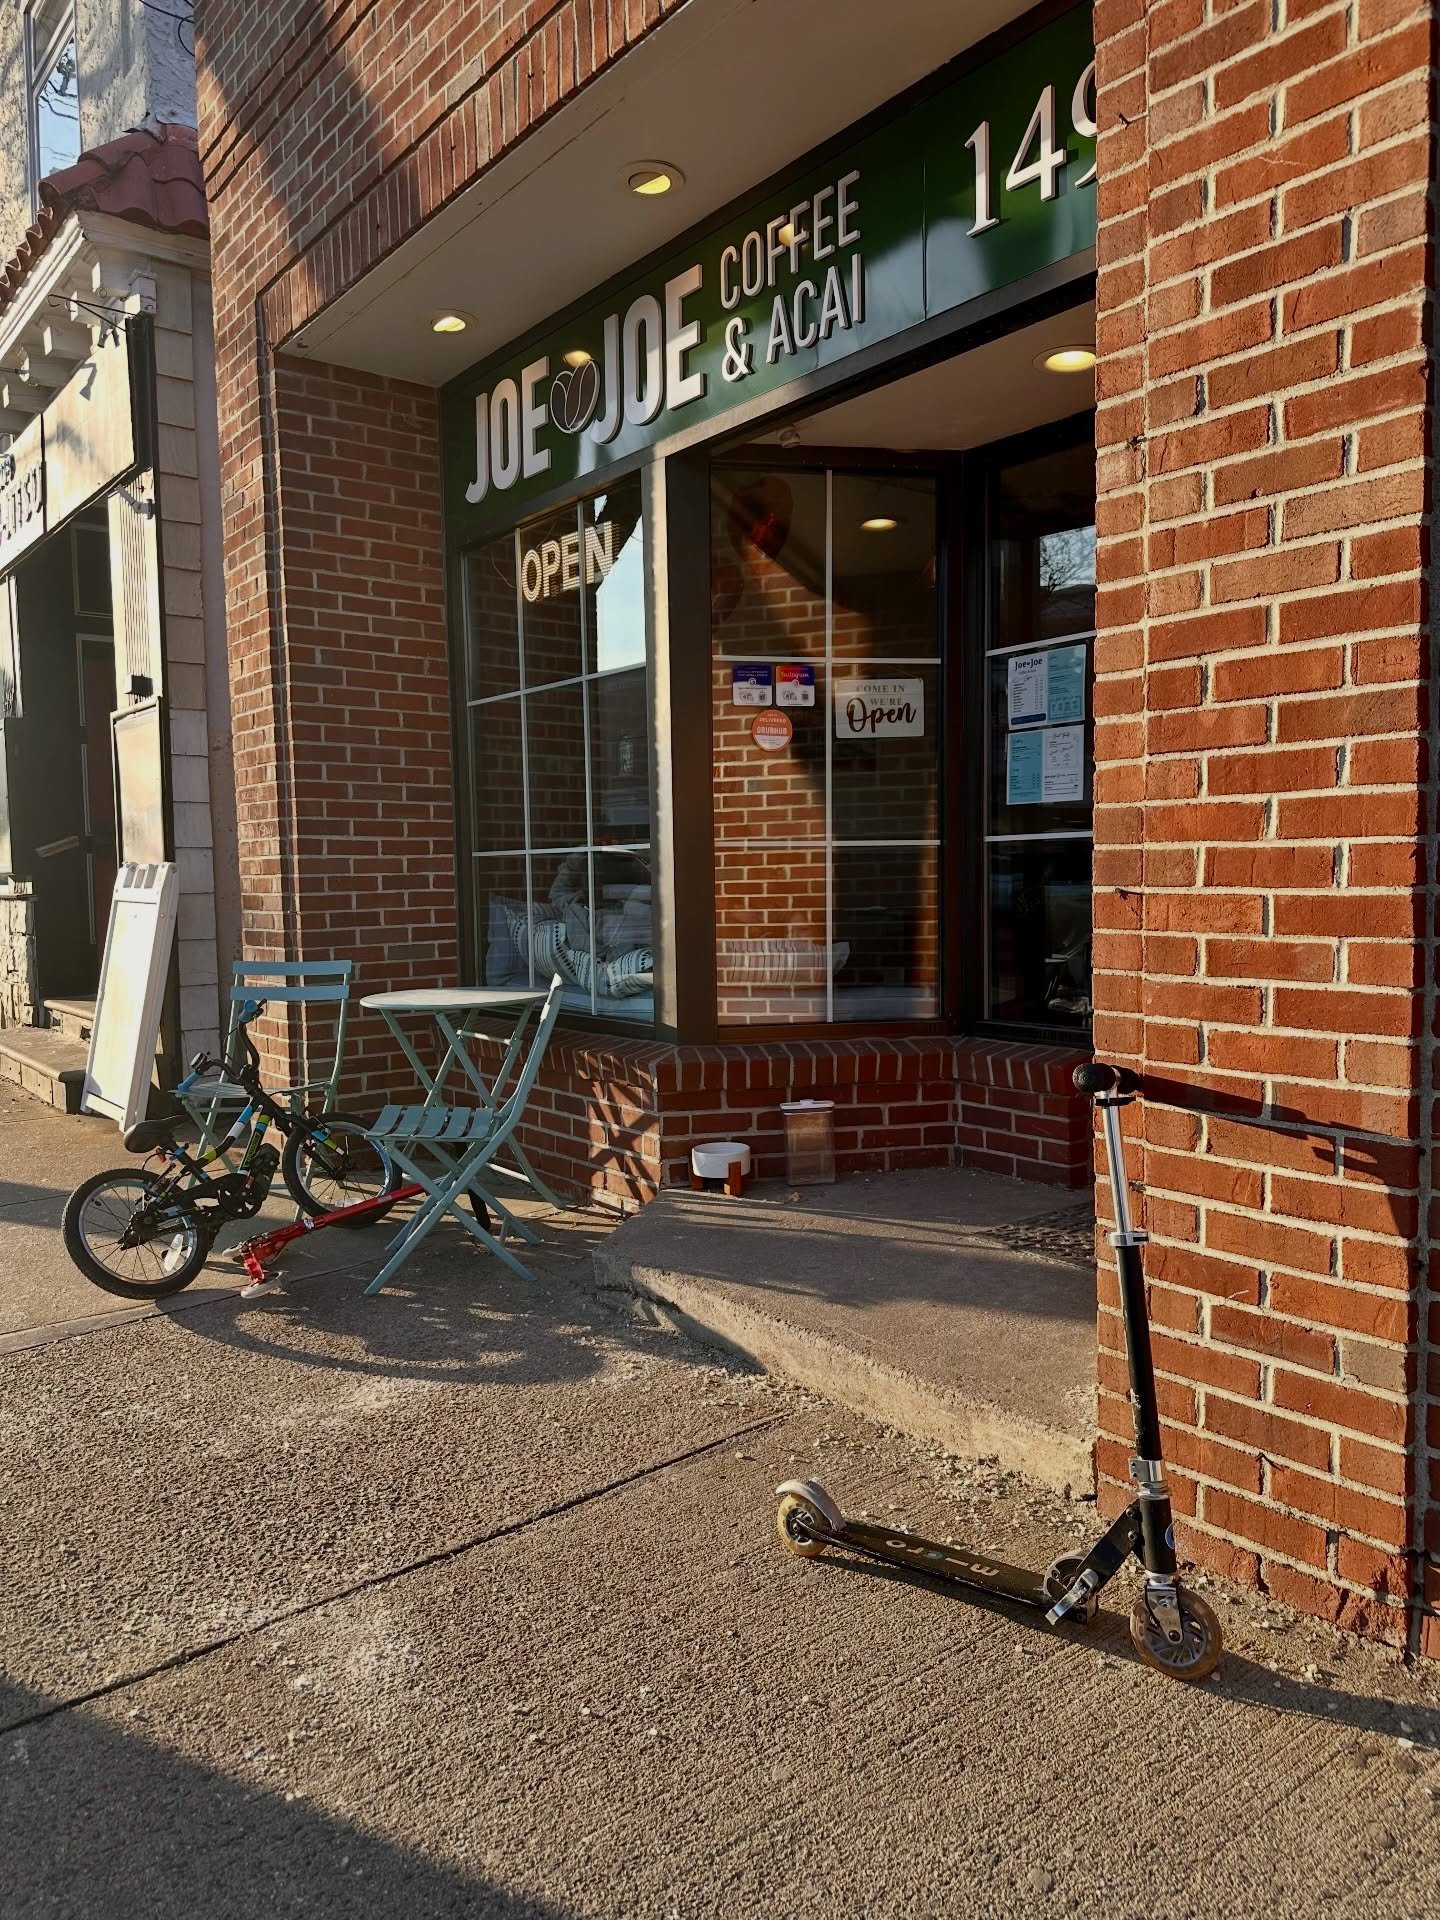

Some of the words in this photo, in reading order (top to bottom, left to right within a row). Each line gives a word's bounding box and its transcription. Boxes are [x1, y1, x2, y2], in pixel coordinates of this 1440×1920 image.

[720, 169, 860, 309] COFFEE
[721, 316, 753, 383] &
[766, 253, 867, 365] ACAI
[465, 356, 551, 504] JOE
[591, 263, 707, 446] JOE
[521, 520, 613, 602] OPEN
[1014, 661, 1027, 672] Joe
[1030, 658, 1043, 669] Joe
[856, 684, 889, 694] COME
[892, 684, 905, 693] IN
[869, 697, 904, 707] WE'RE
[756, 726, 788, 735] GRUBHUB
[846, 697, 917, 734] Open
